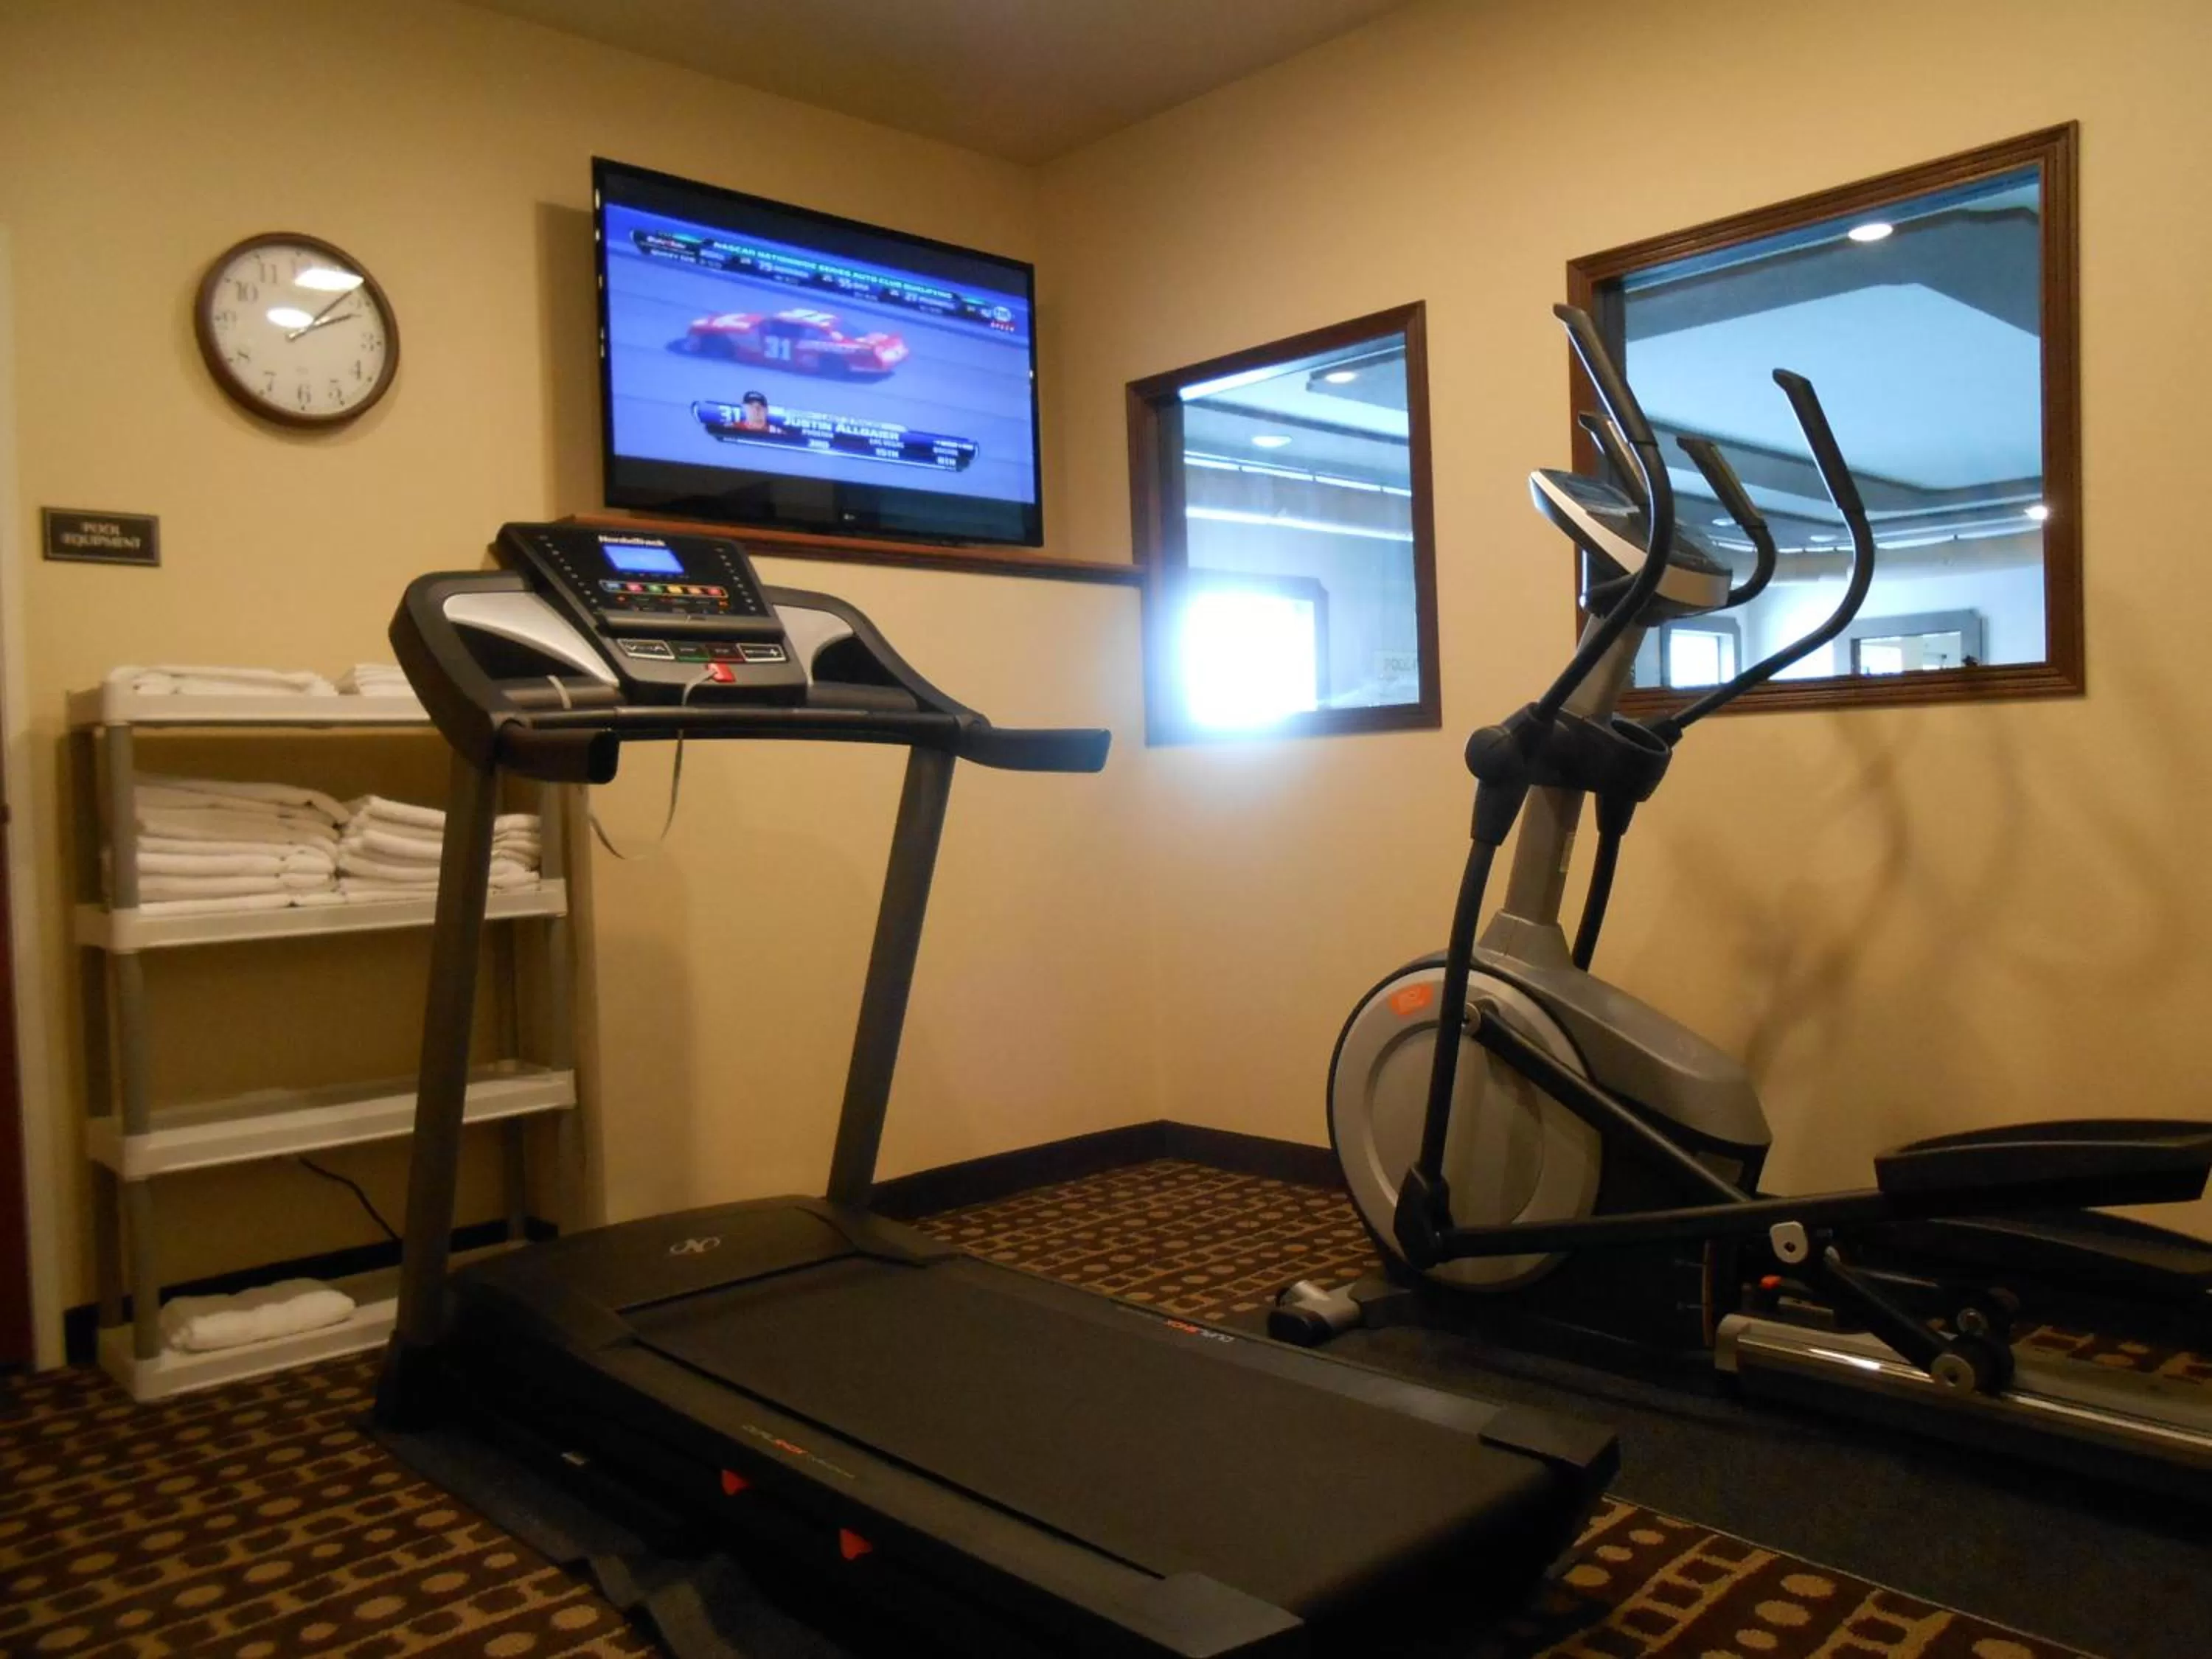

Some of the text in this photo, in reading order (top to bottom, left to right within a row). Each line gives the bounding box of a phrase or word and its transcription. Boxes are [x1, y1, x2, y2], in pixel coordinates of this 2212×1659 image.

[260, 262, 278, 285] 11
[235, 280, 259, 302] 10
[764, 335, 791, 361] 31
[263, 370, 277, 392] 7
[297, 383, 311, 403] 6
[720, 405, 741, 422] 31
[784, 413, 832, 431] JUSTIN
[835, 423, 900, 440] ALLGAIER
[80, 521, 121, 537] POOL
[61, 532, 142, 550] EQUIPMENT
